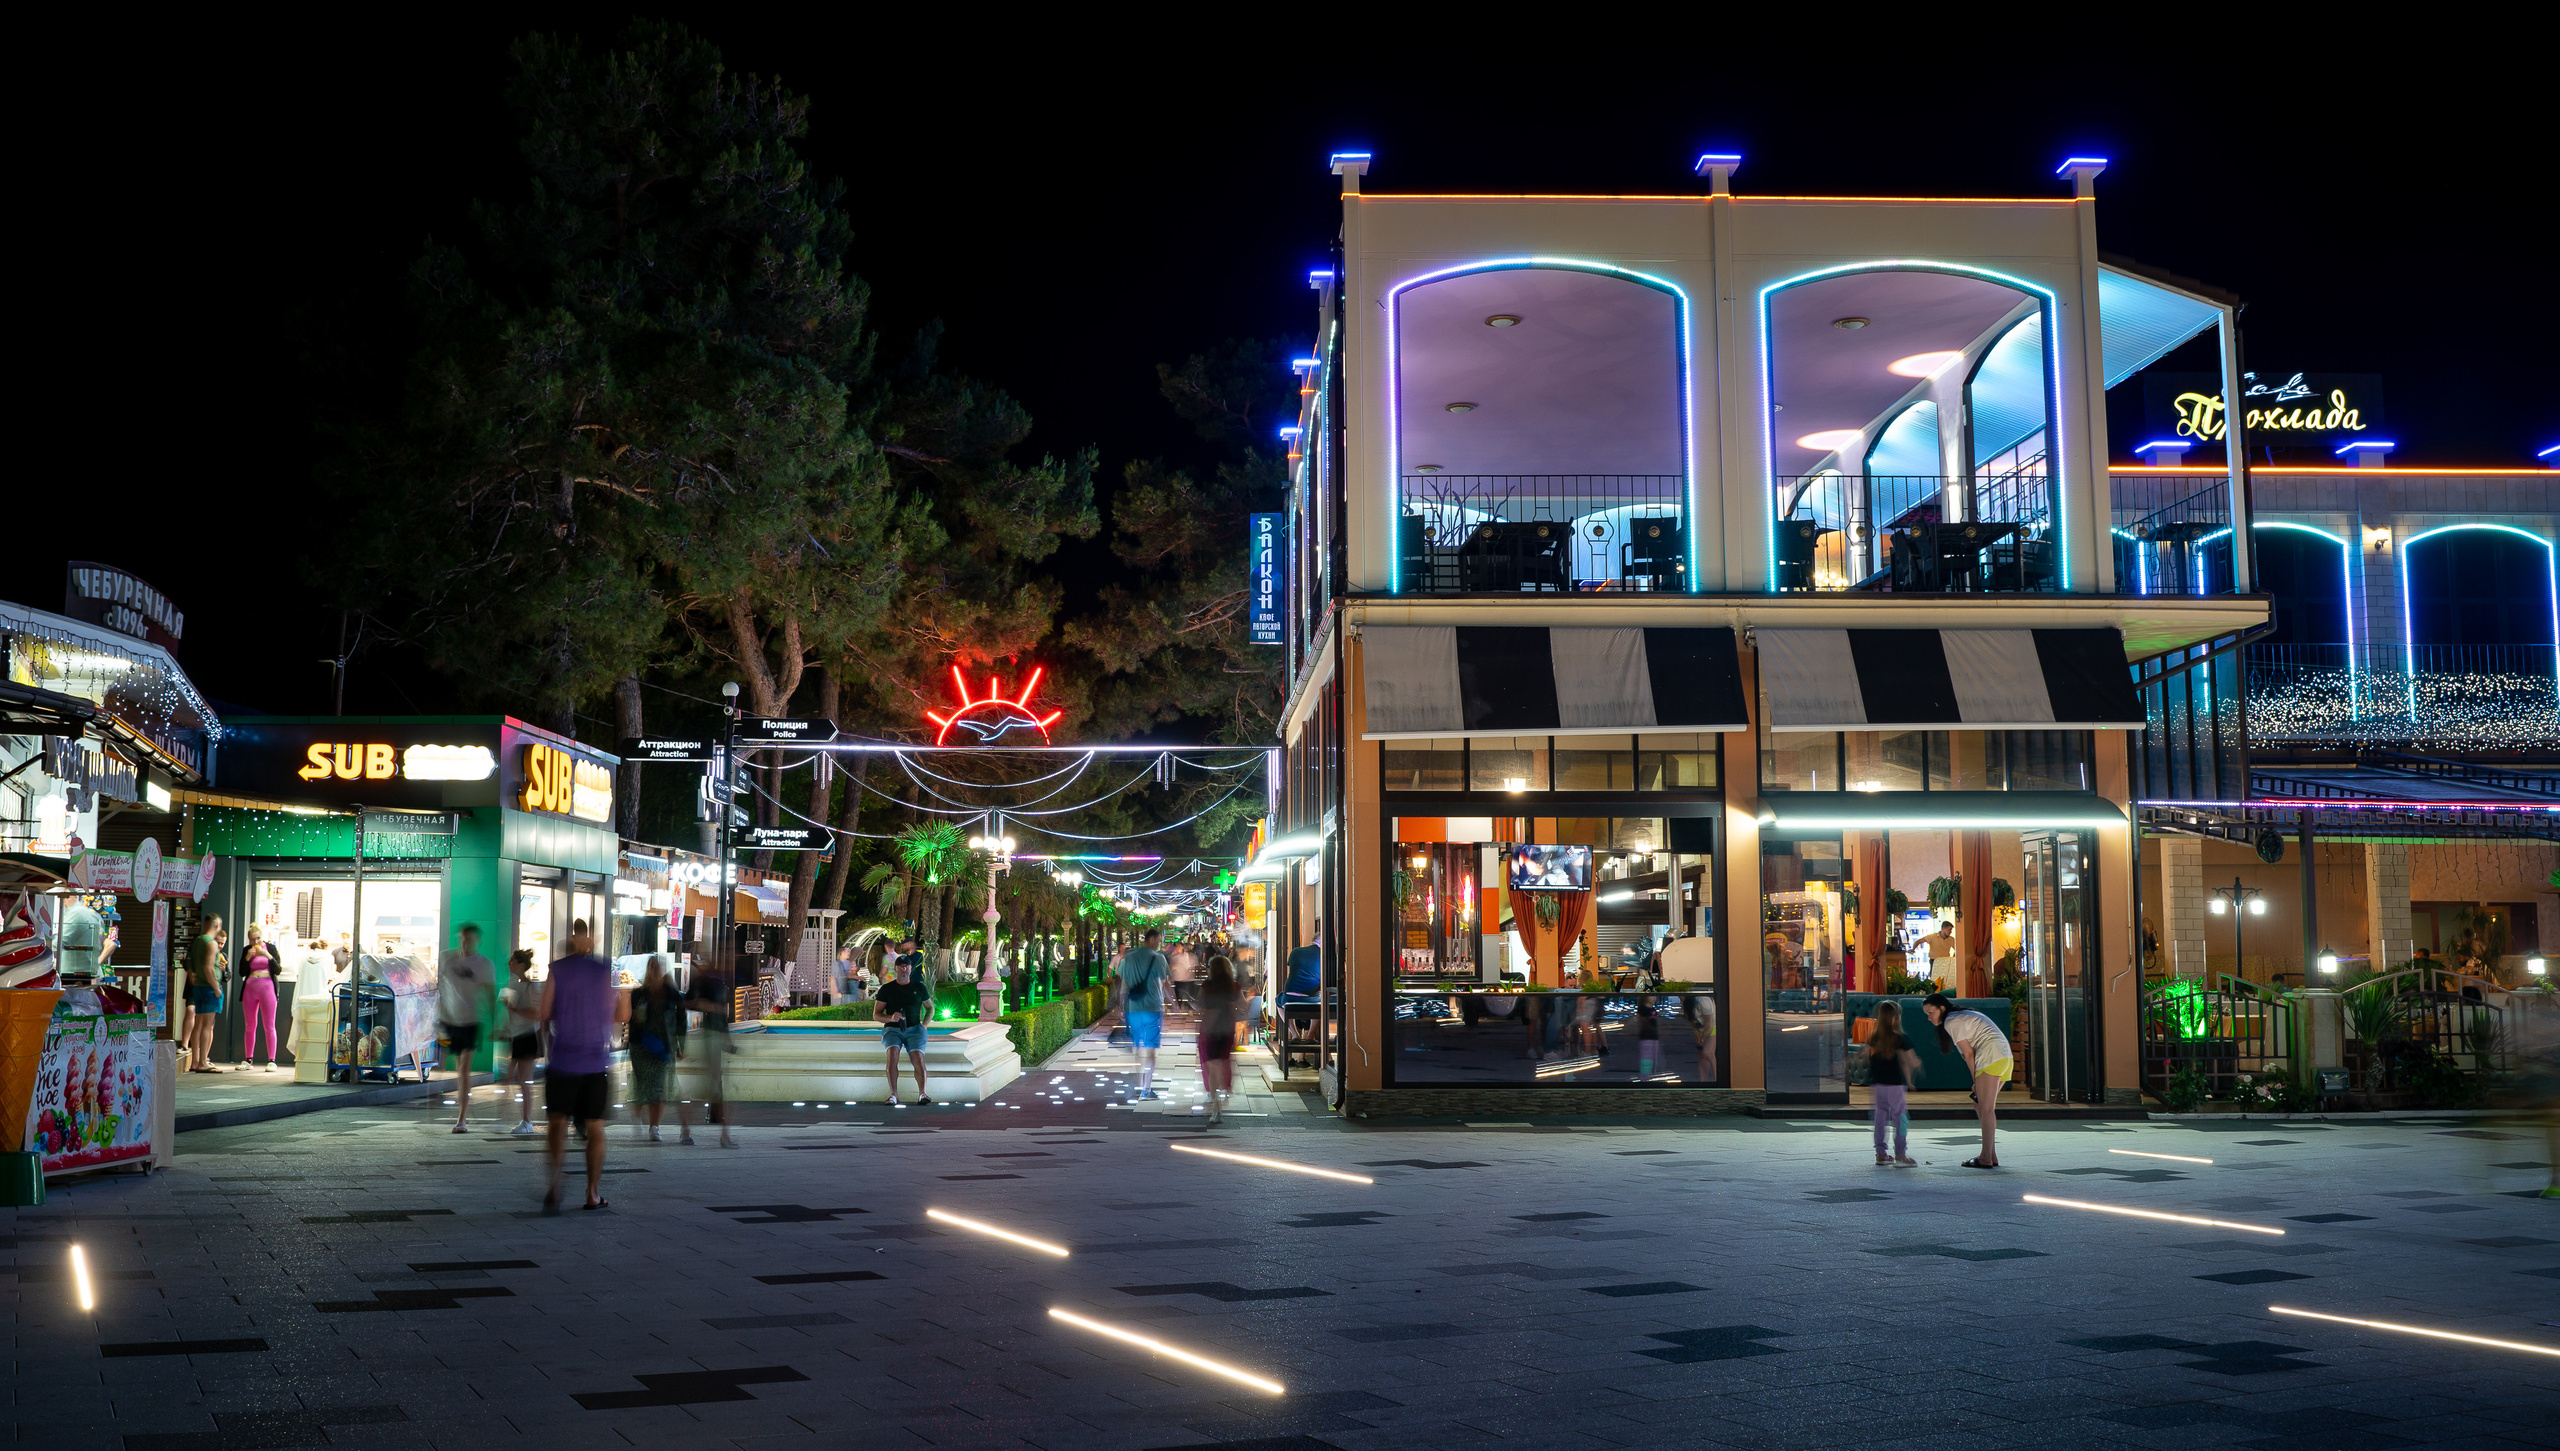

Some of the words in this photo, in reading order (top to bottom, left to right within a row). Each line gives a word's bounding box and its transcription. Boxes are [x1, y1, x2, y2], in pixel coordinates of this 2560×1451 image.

[1257, 517, 1273, 609] БАЛКОН
[74, 568, 184, 640] ЧЕБУРЕЧНАЯ
[762, 720, 808, 731] Полиция
[773, 730, 797, 738] Police
[638, 739, 701, 751] Аттракцион
[649, 750, 689, 758] Attraction
[298, 743, 396, 782] SUB
[518, 743, 573, 813] SUB
[375, 814, 445, 824] ЧЕБУРЕЧНАЯ
[752, 828, 809, 840] Луна-парк
[761, 838, 800, 847] Attraction
[673, 862, 737, 884] КОФЕ
[109, 1018, 154, 1032] НАТУРАЛЬН
